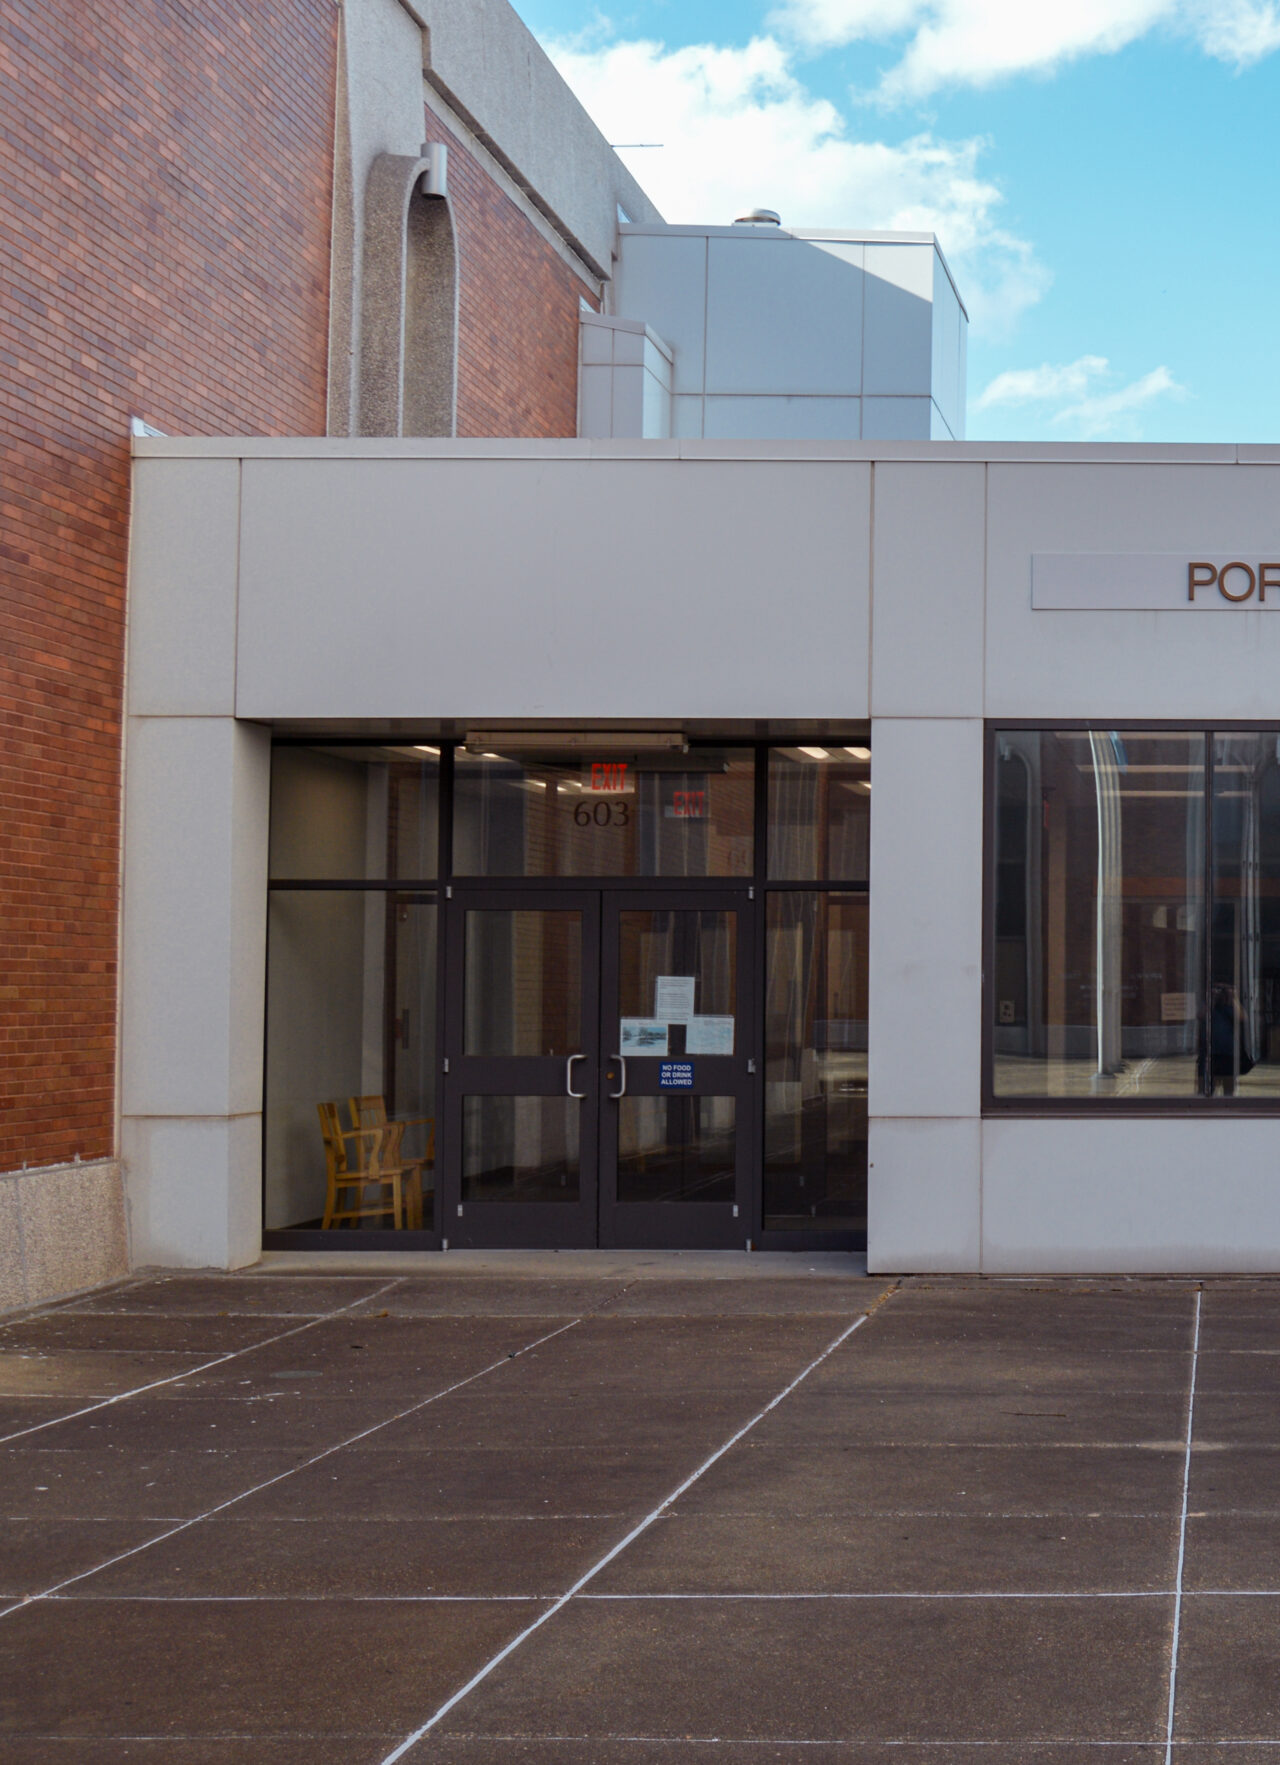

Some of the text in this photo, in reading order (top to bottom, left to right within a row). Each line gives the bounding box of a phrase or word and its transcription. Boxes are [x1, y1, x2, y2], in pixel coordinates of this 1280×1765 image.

[591, 763, 628, 791] EXIT
[573, 801, 630, 827] 603
[673, 791, 705, 815] EXIT
